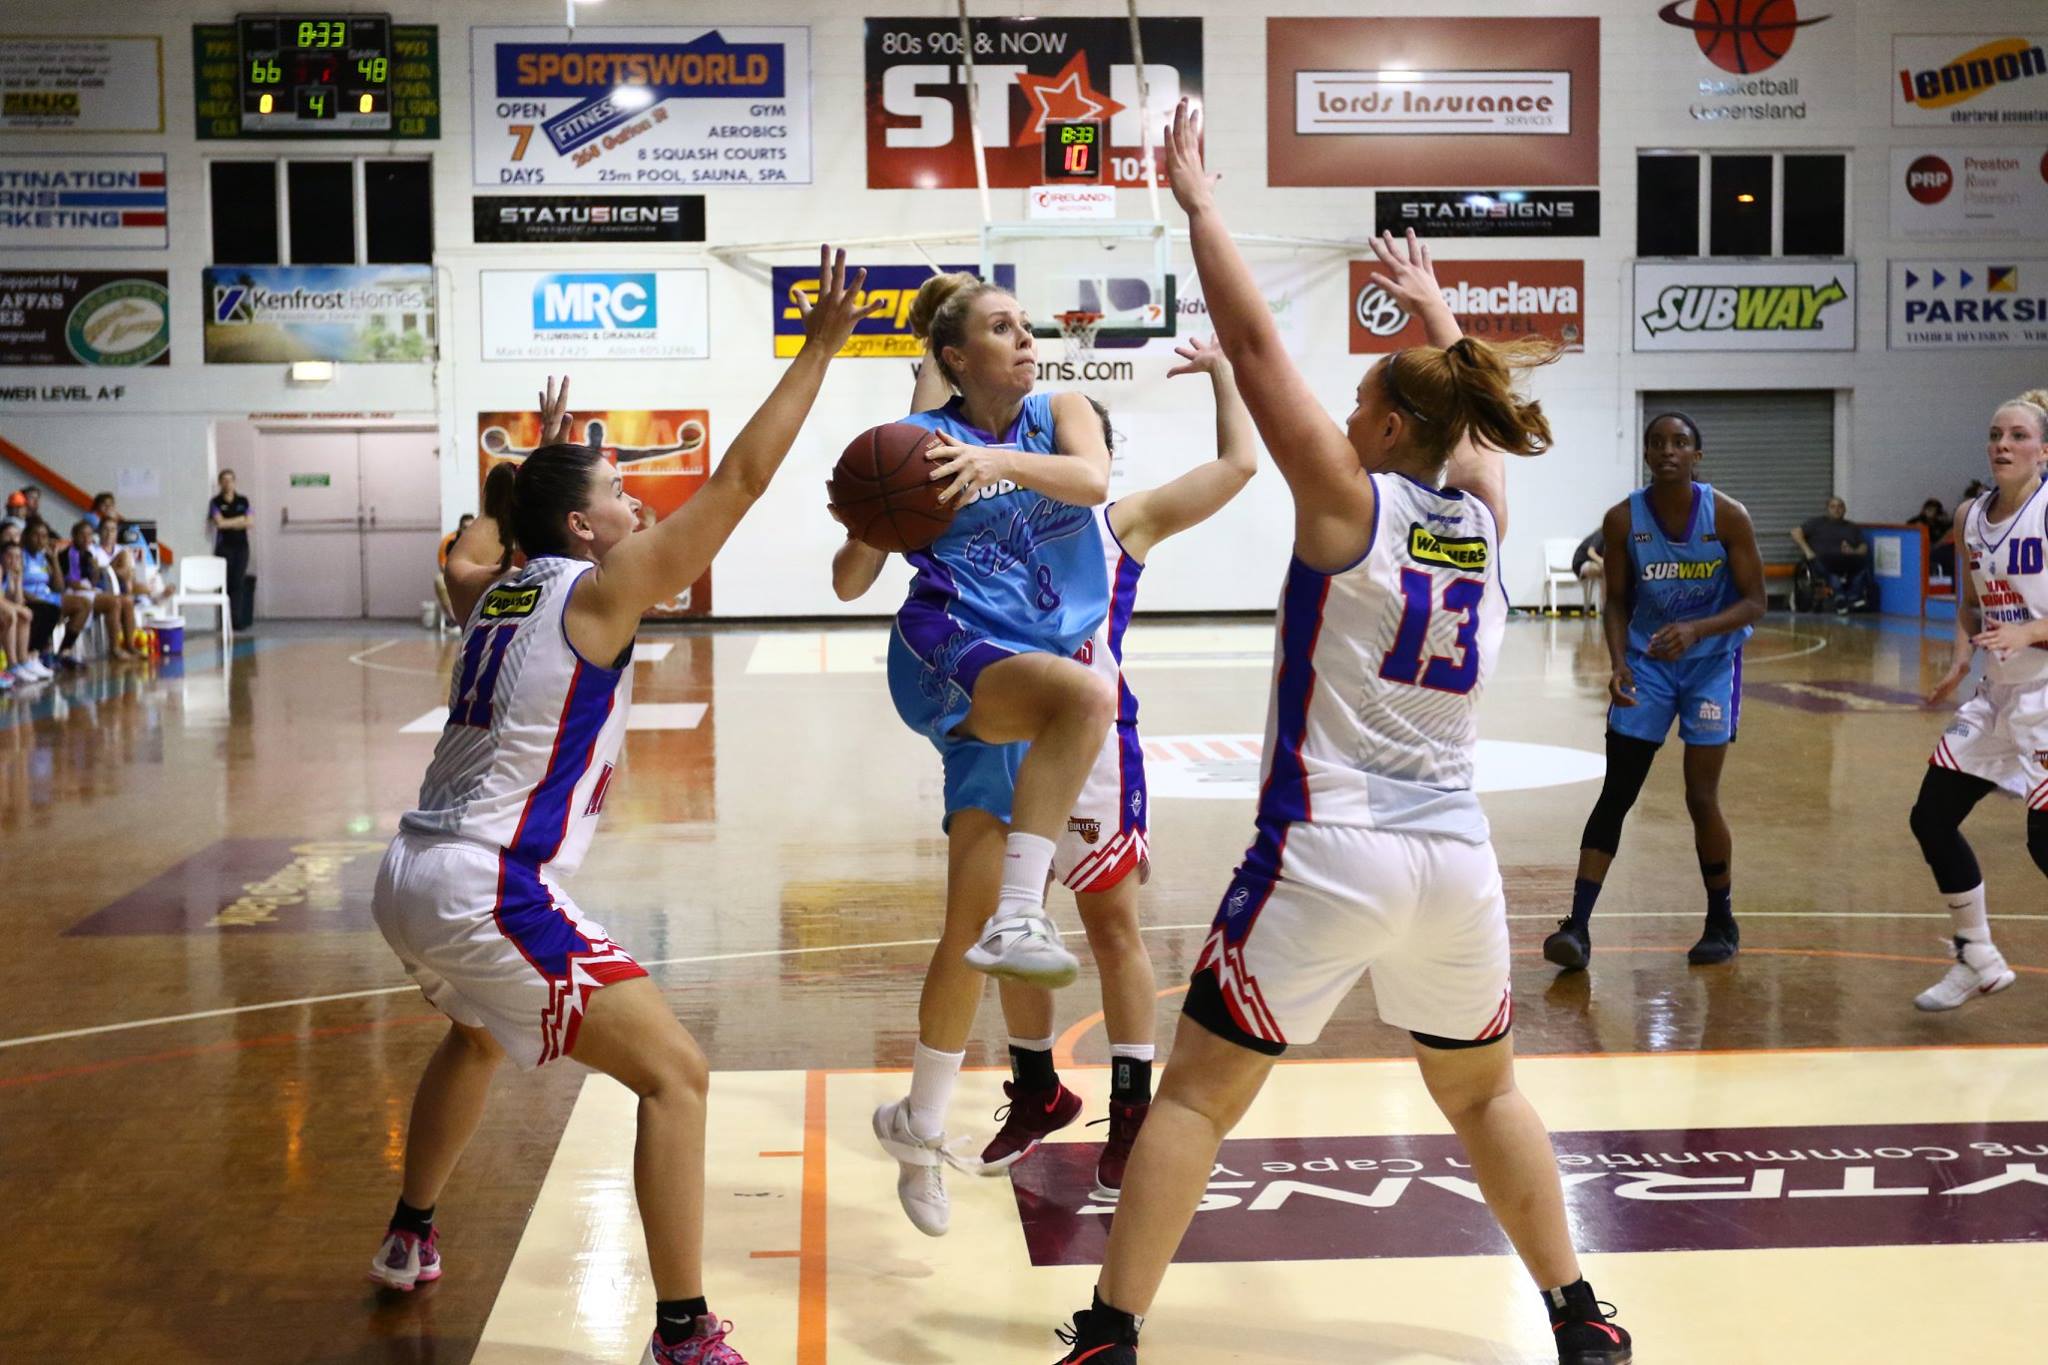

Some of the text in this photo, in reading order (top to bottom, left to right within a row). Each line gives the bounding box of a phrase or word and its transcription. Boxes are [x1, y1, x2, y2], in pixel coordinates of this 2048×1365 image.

[297, 22, 346, 48] 8:33
[883, 32, 1067, 54] 80s 90s & NOW
[252, 57, 388, 83] 66 48
[517, 53, 769, 86] SPORTSWORLD
[1900, 46, 2047, 103] lennon
[308, 95, 325, 118] 4
[496, 102, 546, 119] OPEN
[749, 104, 786, 117] GYM
[1318, 90, 1553, 113] Lords Insurance
[508, 125, 535, 162] 7
[708, 126, 787, 139] AEROBICS
[1061, 126, 1094, 144] 8:33
[637, 148, 787, 160] 8 SQUASH COURTS
[1064, 144, 1088, 171] 10
[1964, 157, 2020, 171] Preston
[500, 168, 545, 184] DAYS
[598, 169, 787, 184] 25m POOL, SAUNA, SPA
[1110, 157, 1166, 181] 102.
[1910, 171, 1949, 188] PRP
[253, 288, 422, 309] Kenfrost Homes
[544, 282, 648, 330] MRC
[1440, 281, 1578, 314] alaclava
[1641, 277, 1847, 337] SUBWAY
[1906, 299, 2047, 322] PARKSI
[1416, 536, 1486, 563] WANERS
[2007, 537, 2043, 575] 10
[1642, 560, 1722, 581] SUBWAY
[1037, 565, 1061, 612] 8
[1378, 565, 1486, 696] 13
[1262, 1157, 1414, 1174] Cape
[1556, 1146, 1960, 1169] Communitie
